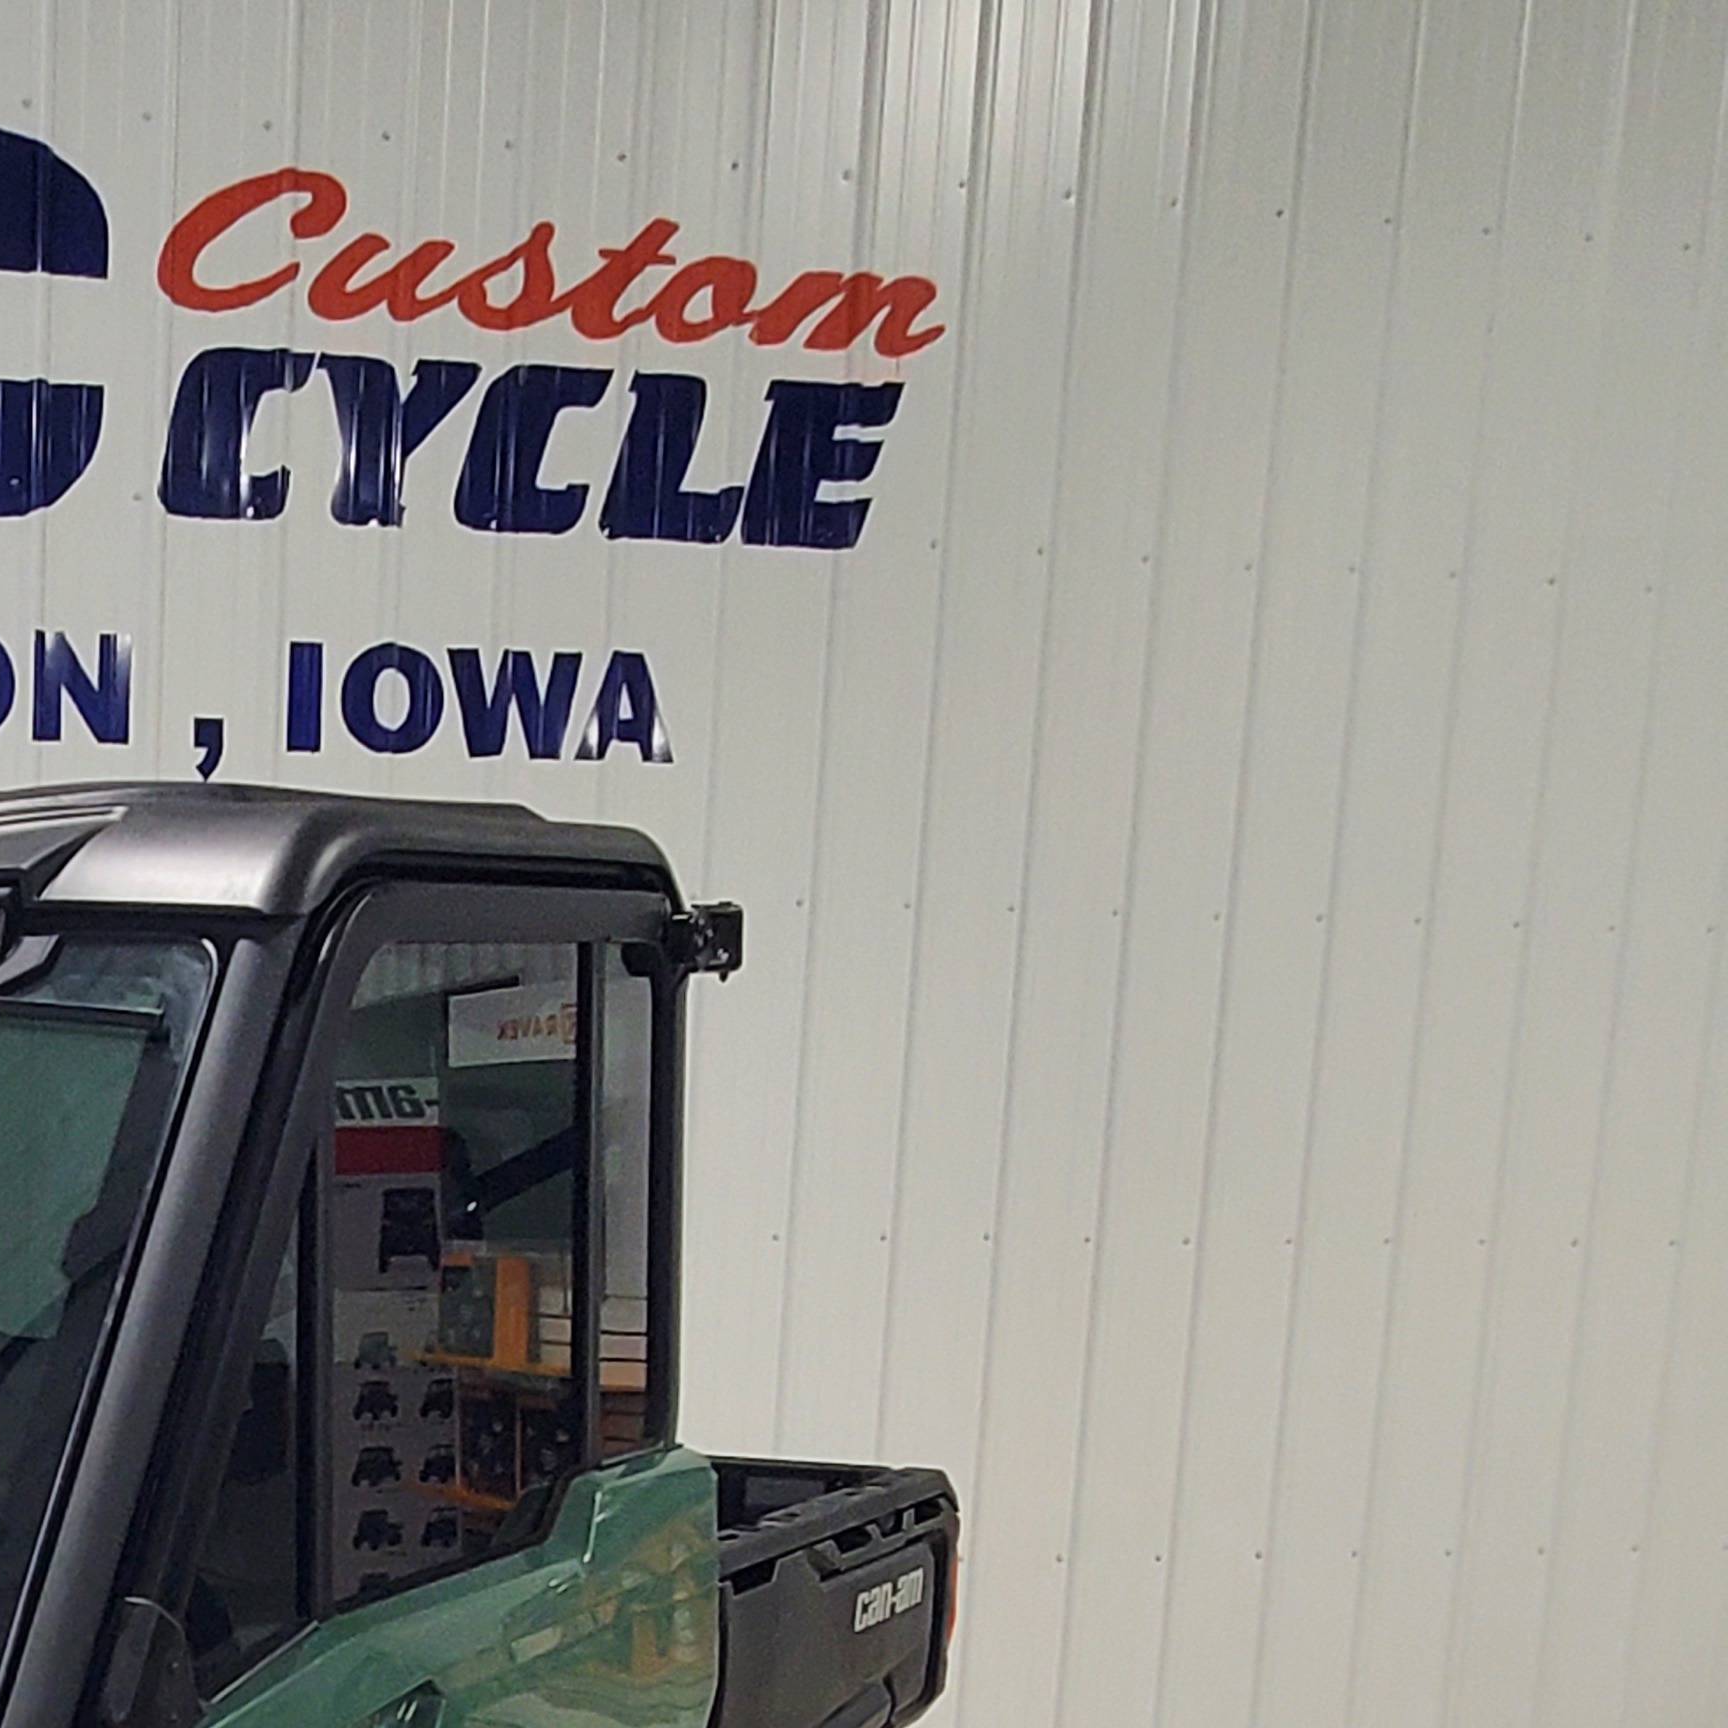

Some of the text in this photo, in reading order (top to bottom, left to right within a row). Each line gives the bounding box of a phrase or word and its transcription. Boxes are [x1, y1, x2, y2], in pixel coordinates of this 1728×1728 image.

[156, 168, 945, 357] Custom
[158, 348, 905, 549] CYCLE
[286, 641, 674, 763] IOWA
